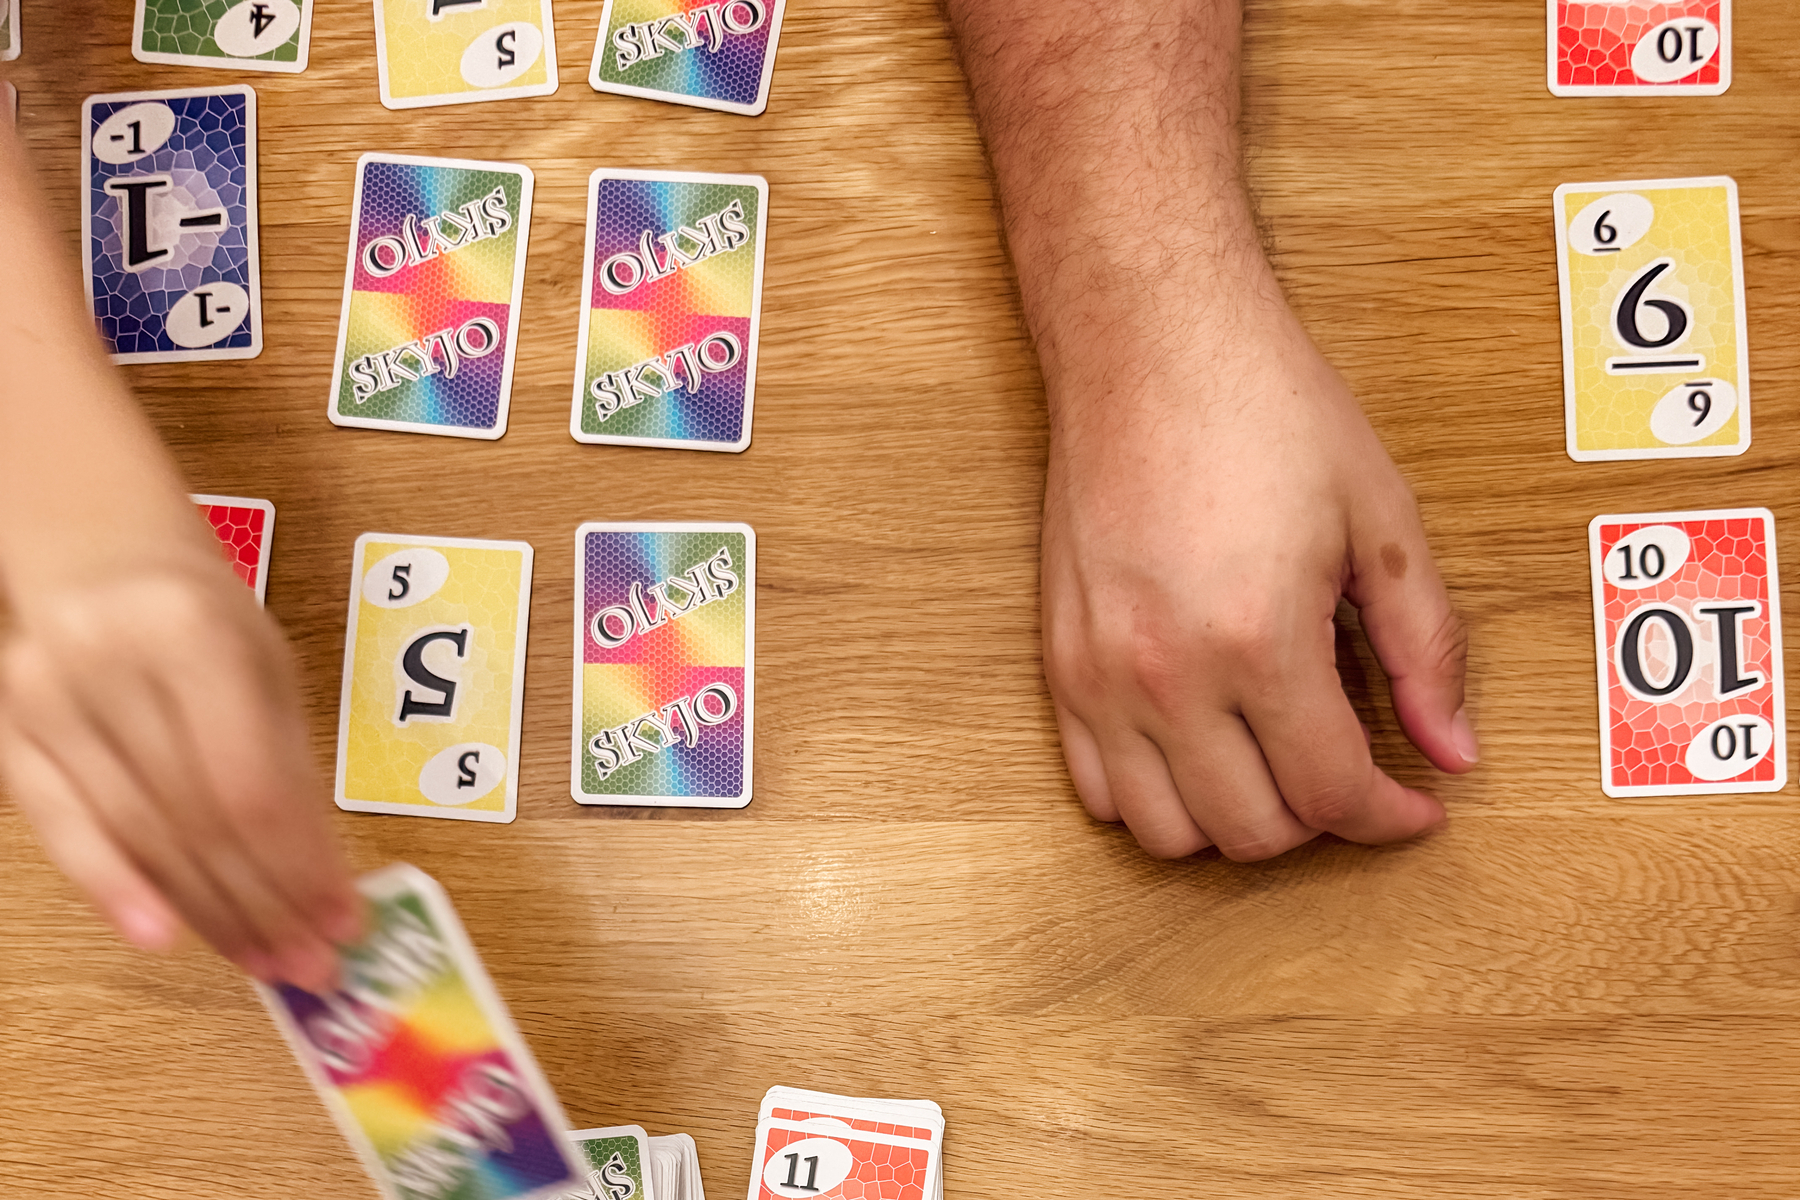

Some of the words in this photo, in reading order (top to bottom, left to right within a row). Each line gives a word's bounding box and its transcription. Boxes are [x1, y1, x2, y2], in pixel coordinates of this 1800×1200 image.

[250, 4, 276, 39] 4
[613, 0, 766, 71] SKYJO
[496, 30, 516, 70] 5
[1657, 27, 1705, 64] 10
[110, 121, 146, 155] -1
[109, 180, 223, 267] -1
[363, 186, 512, 278] SKYJO
[1593, 210, 1619, 246] 6
[600, 200, 750, 295] SKYJO
[194, 292, 231, 328] -1
[1615, 263, 1692, 352] 6
[349, 317, 499, 403] SKYJO
[591, 331, 741, 422] SKYJO
[1686, 388, 1712, 427] 6
[1617, 543, 1665, 580] 10
[388, 563, 412, 601] 5
[591, 547, 740, 648] SKYJO
[1621, 606, 1759, 697] 10
[398, 628, 469, 723] 5
[588, 682, 737, 780] SKYJO
[1711, 724, 1759, 761] 10
[456, 750, 480, 789] 5
[779, 1152, 821, 1191] 11
